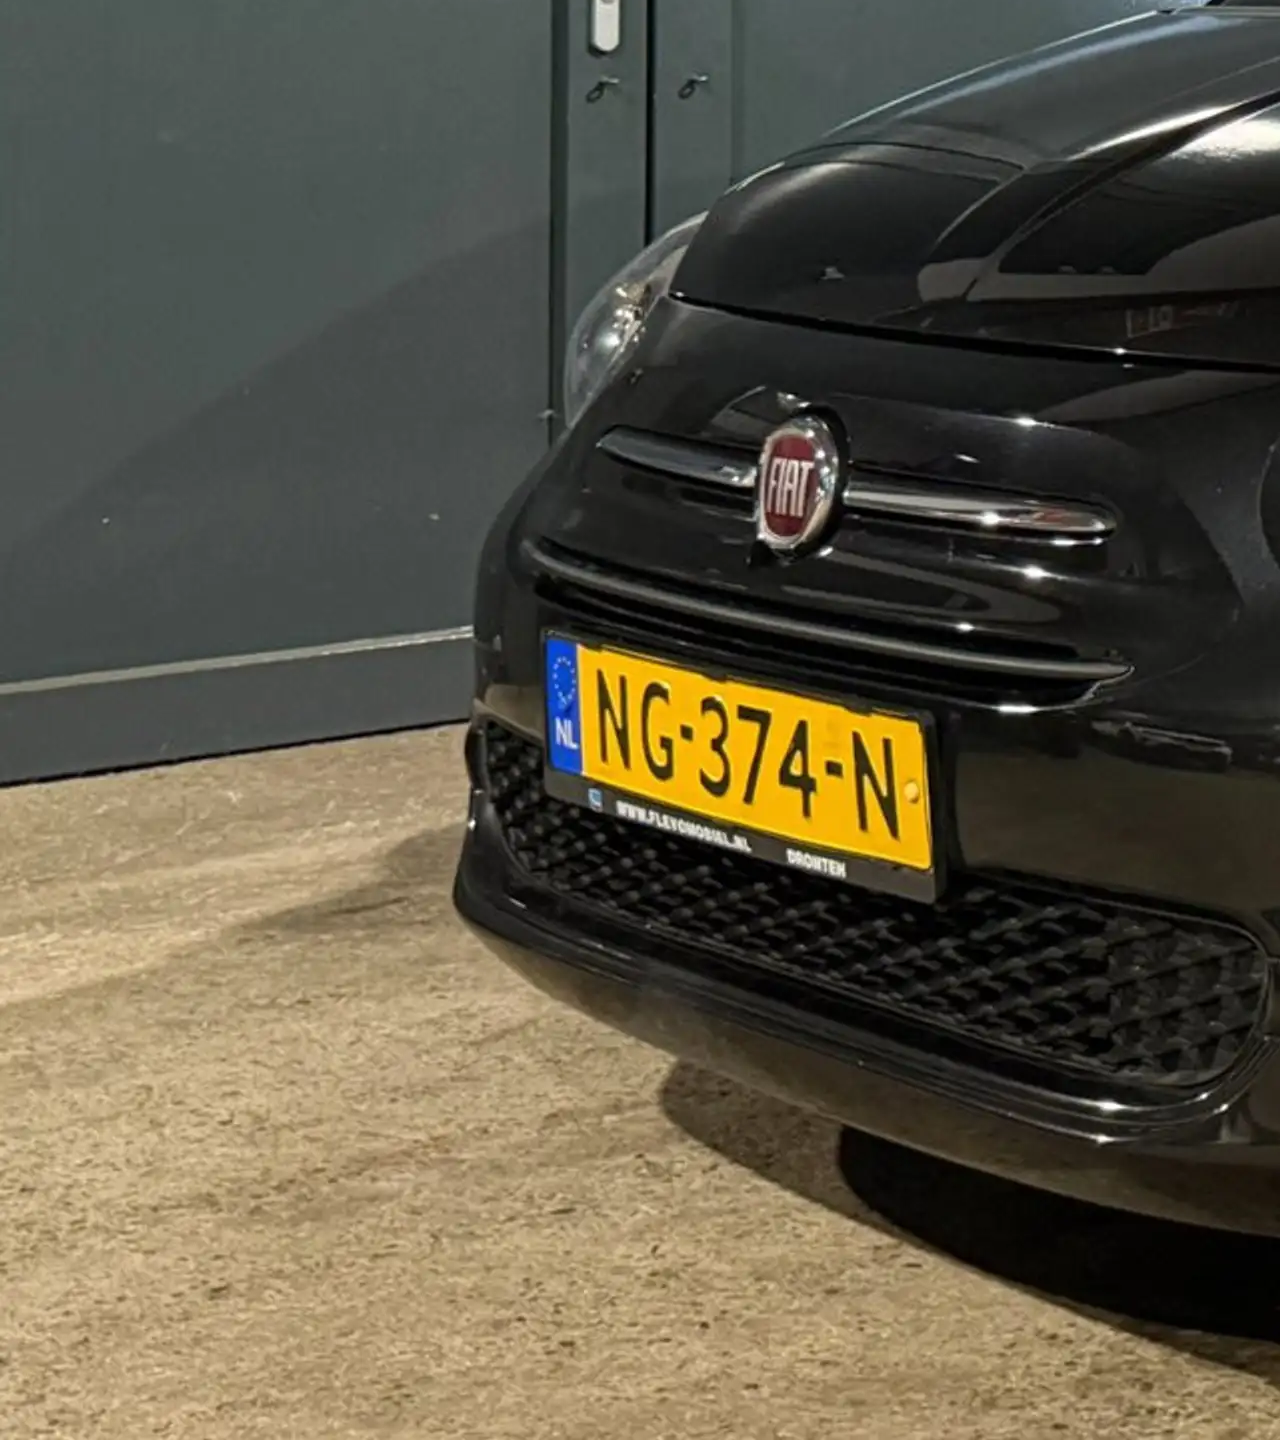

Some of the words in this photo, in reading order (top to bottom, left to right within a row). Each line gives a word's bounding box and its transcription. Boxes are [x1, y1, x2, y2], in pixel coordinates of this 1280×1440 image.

[766, 456, 816, 519] FIAT
[555, 716, 579, 750] NL
[596, 667, 901, 841] NG-374-N
